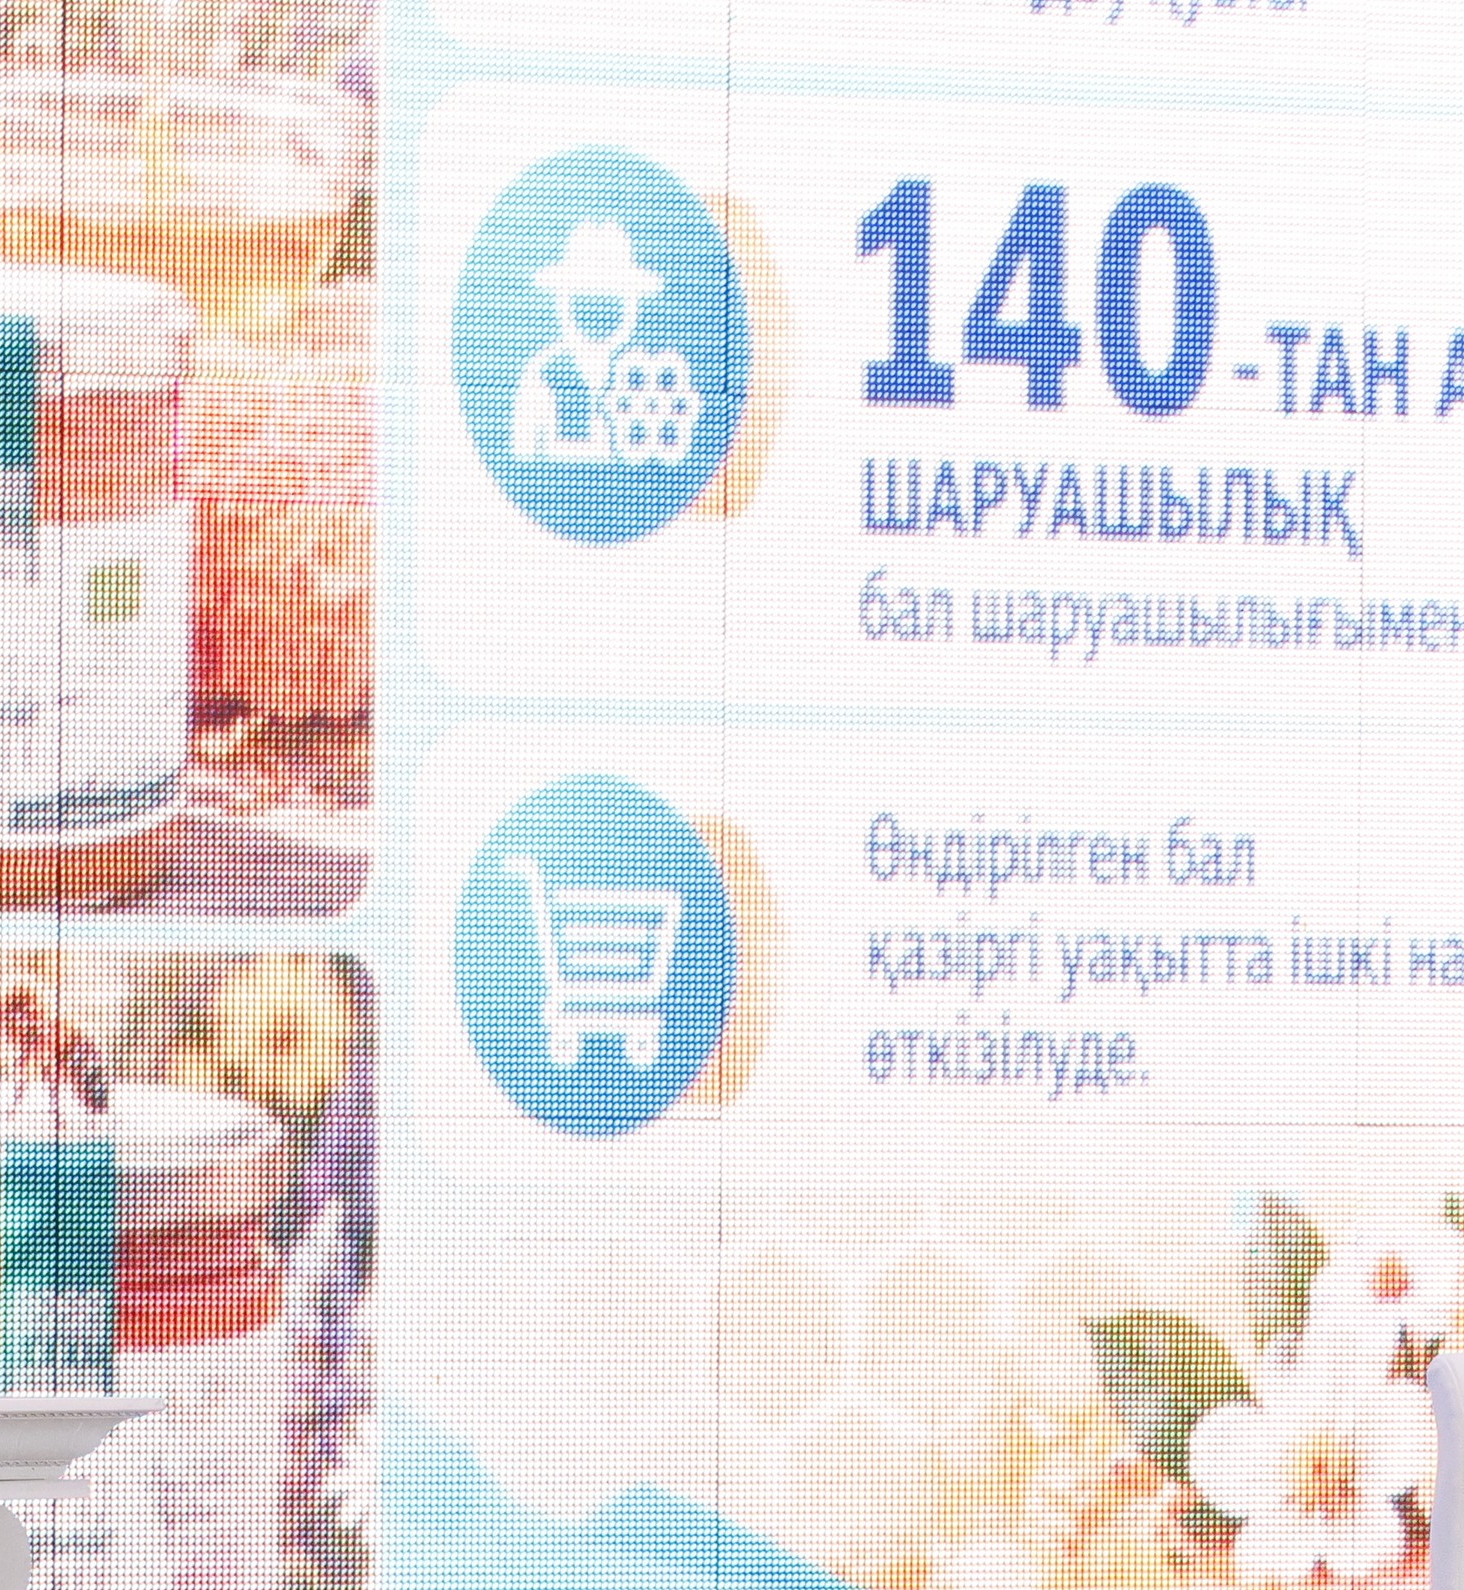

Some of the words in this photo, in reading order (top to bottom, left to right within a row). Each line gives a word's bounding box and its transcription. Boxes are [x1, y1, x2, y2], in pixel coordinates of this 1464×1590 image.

[860, 458, 1363, 559] ШАРУАШЫЛЫҚ
[859, 566, 954, 642] бал
[867, 812, 1150, 900] Өндірілген
[1167, 815, 1257, 886] бал
[868, 911, 1040, 1002] қазіргі
[1056, 931, 1274, 1003] уақытта
[1291, 915, 1393, 986] ішкі
[866, 1009, 1149, 1101] өткізілуде.
